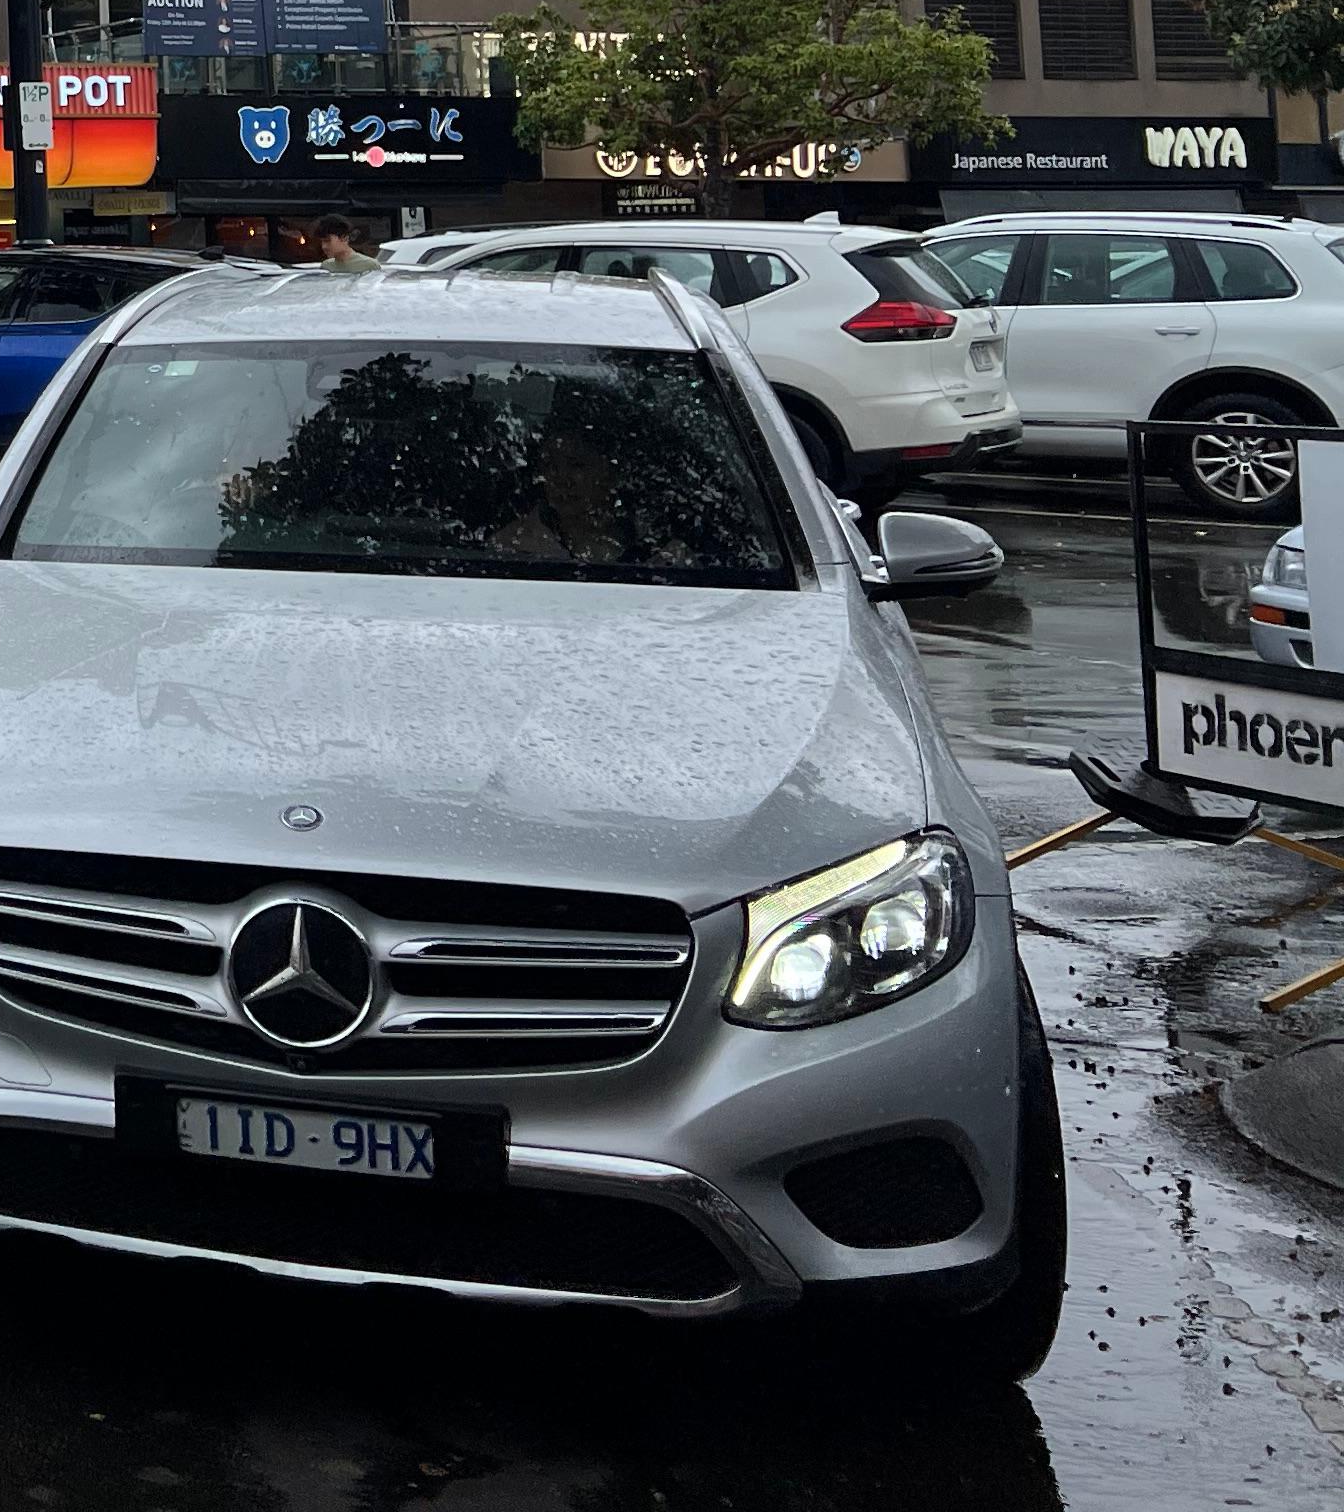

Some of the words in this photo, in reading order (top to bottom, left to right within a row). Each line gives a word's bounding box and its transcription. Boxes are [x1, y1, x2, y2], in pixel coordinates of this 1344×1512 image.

[59, 74, 132, 108] POT
[952, 153, 1023, 173] Japanese
[1026, 153, 1109, 170] Restaurant
[1144, 126, 1248, 169] WAYA
[333, 1120, 435, 1176] 9HX
